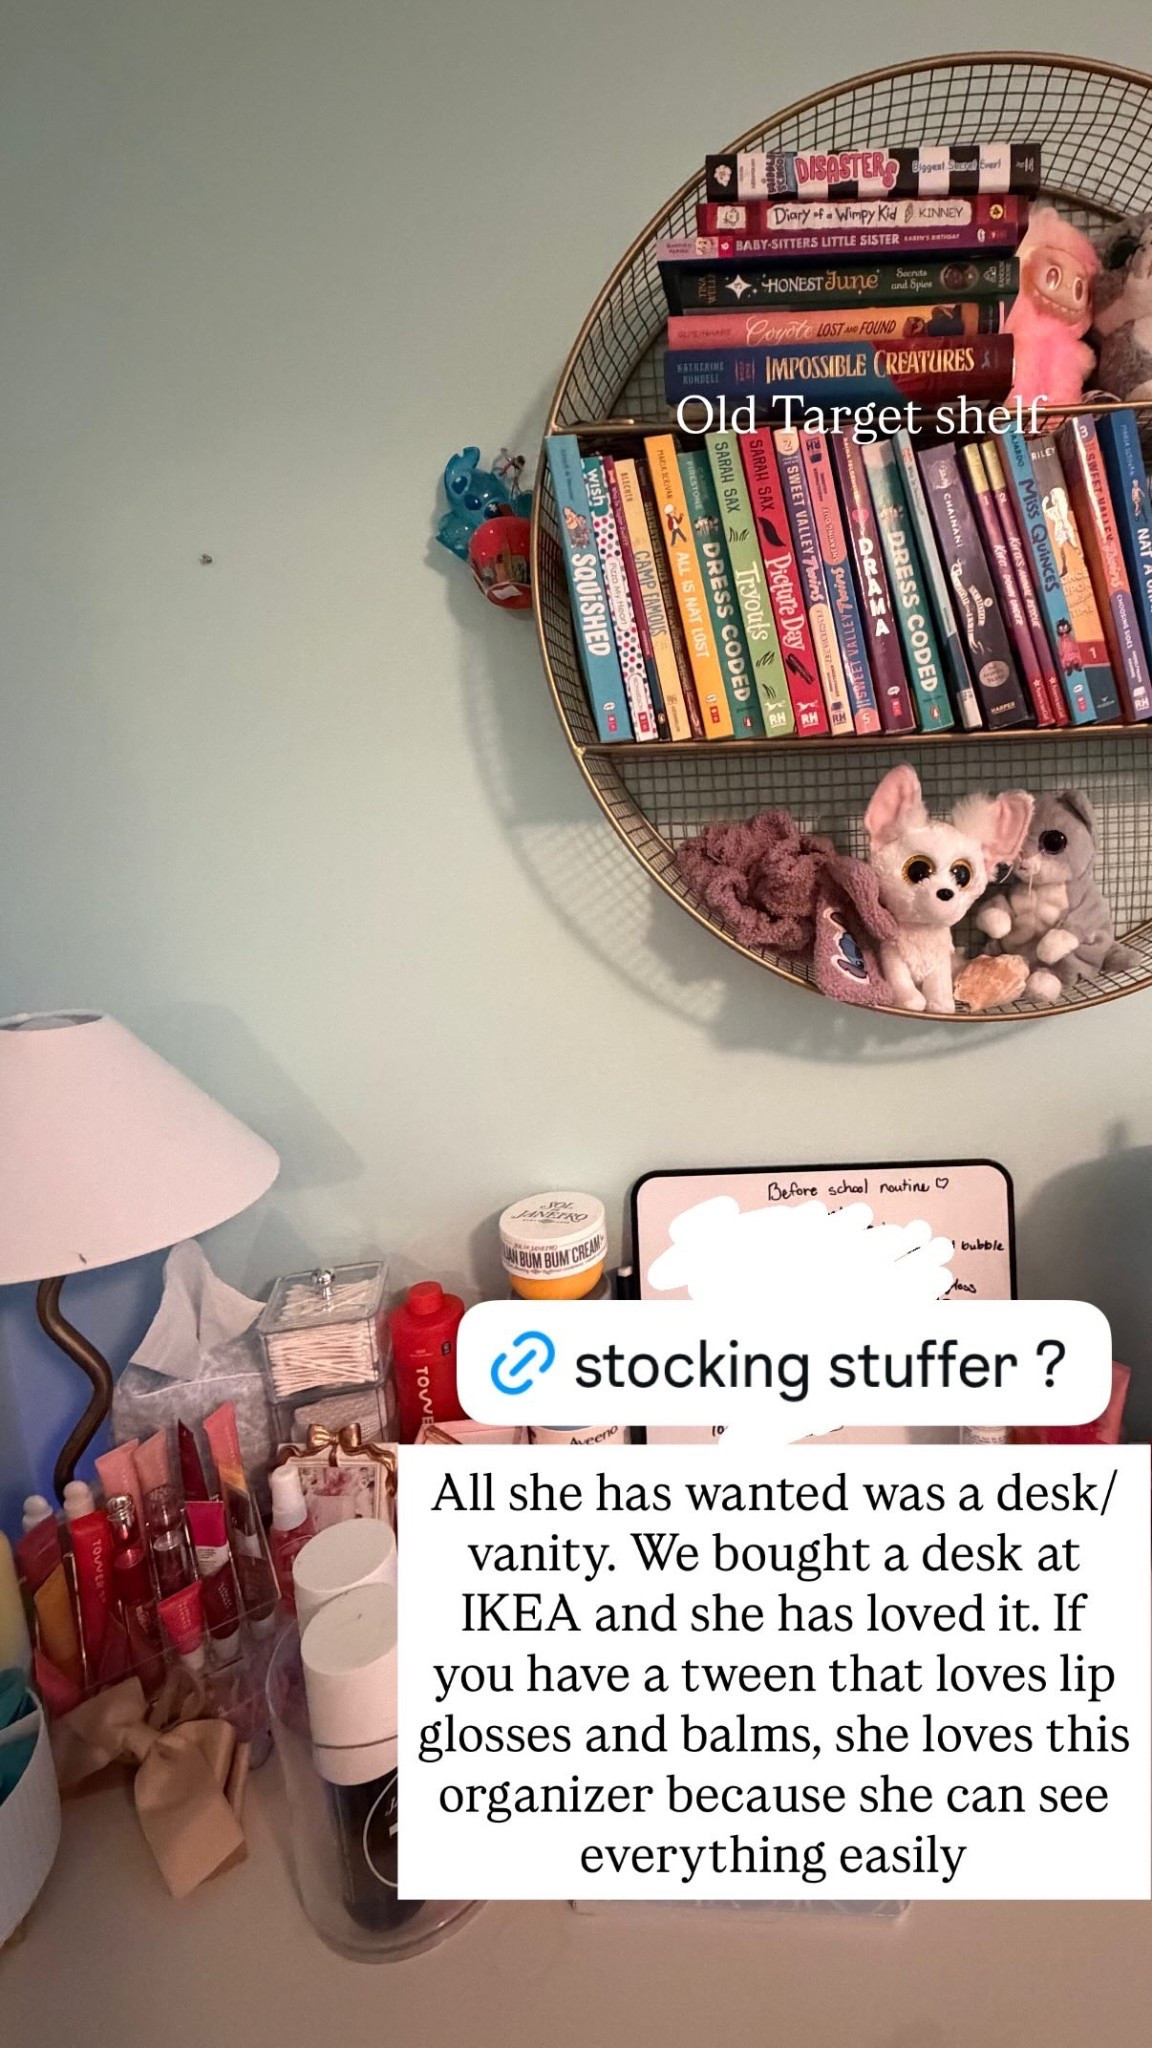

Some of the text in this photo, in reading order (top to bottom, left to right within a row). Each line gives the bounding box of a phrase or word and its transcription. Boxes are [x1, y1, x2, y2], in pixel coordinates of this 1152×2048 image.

[911, 160, 945, 173] Biggest
[948, 158, 978, 171] Secret
[979, 158, 1001, 170] Ever!
[773, 207, 811, 226] Diary
[813, 208, 824, 220] of
[834, 206, 876, 225] Wimpy
[878, 204, 898, 221] Kid
[918, 207, 963, 219] KINNEY
[736, 237, 819, 251] BABY-SITTERS
[821, 235, 857, 249] LITTLE
[859, 233, 900, 247] SISTER
[762, 269, 879, 294] HONEST June
[890, 278, 933, 292] and Spies
[817, 321, 844, 337] LOST
[858, 320, 896, 335] FOUND
[676, 361, 724, 373] KATHERINE
[765, 352, 867, 384] IMPOSSIBLE
[873, 347, 975, 378] CREATURES
[1079, 426, 1089, 438] 3
[1031, 447, 1056, 461] RILEY
[713, 441, 741, 513] SARAH SAX
[748, 438, 775, 512] SARAH SAX
[786, 465, 805, 506] SWEET
[1087, 454, 1103, 493] SWEET
[587, 468, 605, 507] wish
[982, 495, 990, 506] 1
[794, 510, 814, 555] VALLEY
[943, 492, 964, 548] CHAINANI
[674, 550, 692, 575] ALL
[993, 542, 1010, 568] Kira
[680, 579, 696, 593] IS
[802, 554, 824, 601] Twins
[858, 538, 890, 636] DRAMA
[633, 549, 667, 638] CAMP FAMOUS
[732, 560, 772, 643] Tryouts
[763, 551, 809, 654] Picture Day
[684, 595, 702, 624] NAT
[702, 540, 751, 702] DRESS CODED
[888, 531, 938, 692] DRESS CODED
[690, 627, 710, 659] LOST
[839, 612, 859, 656] VALLEY
[1088, 646, 1097, 659] 1
[849, 659, 868, 699] SWEET
[1135, 698, 1149, 710] RH
[769, 712, 787, 724] RH
[801, 711, 818, 724] RH
[832, 714, 846, 725] RH
[768, 1179, 930, 1200] Before school routine
[511, 1210, 588, 1223] JANEIRO
[547, 1201, 573, 1209] SOL
[519, 1251, 542, 1269] BUM
[544, 1249, 570, 1269] BUM
[571, 1234, 601, 1264] CREAM
[961, 1239, 1004, 1251] bubble
[570, 1425, 619, 1444] Aveeno
